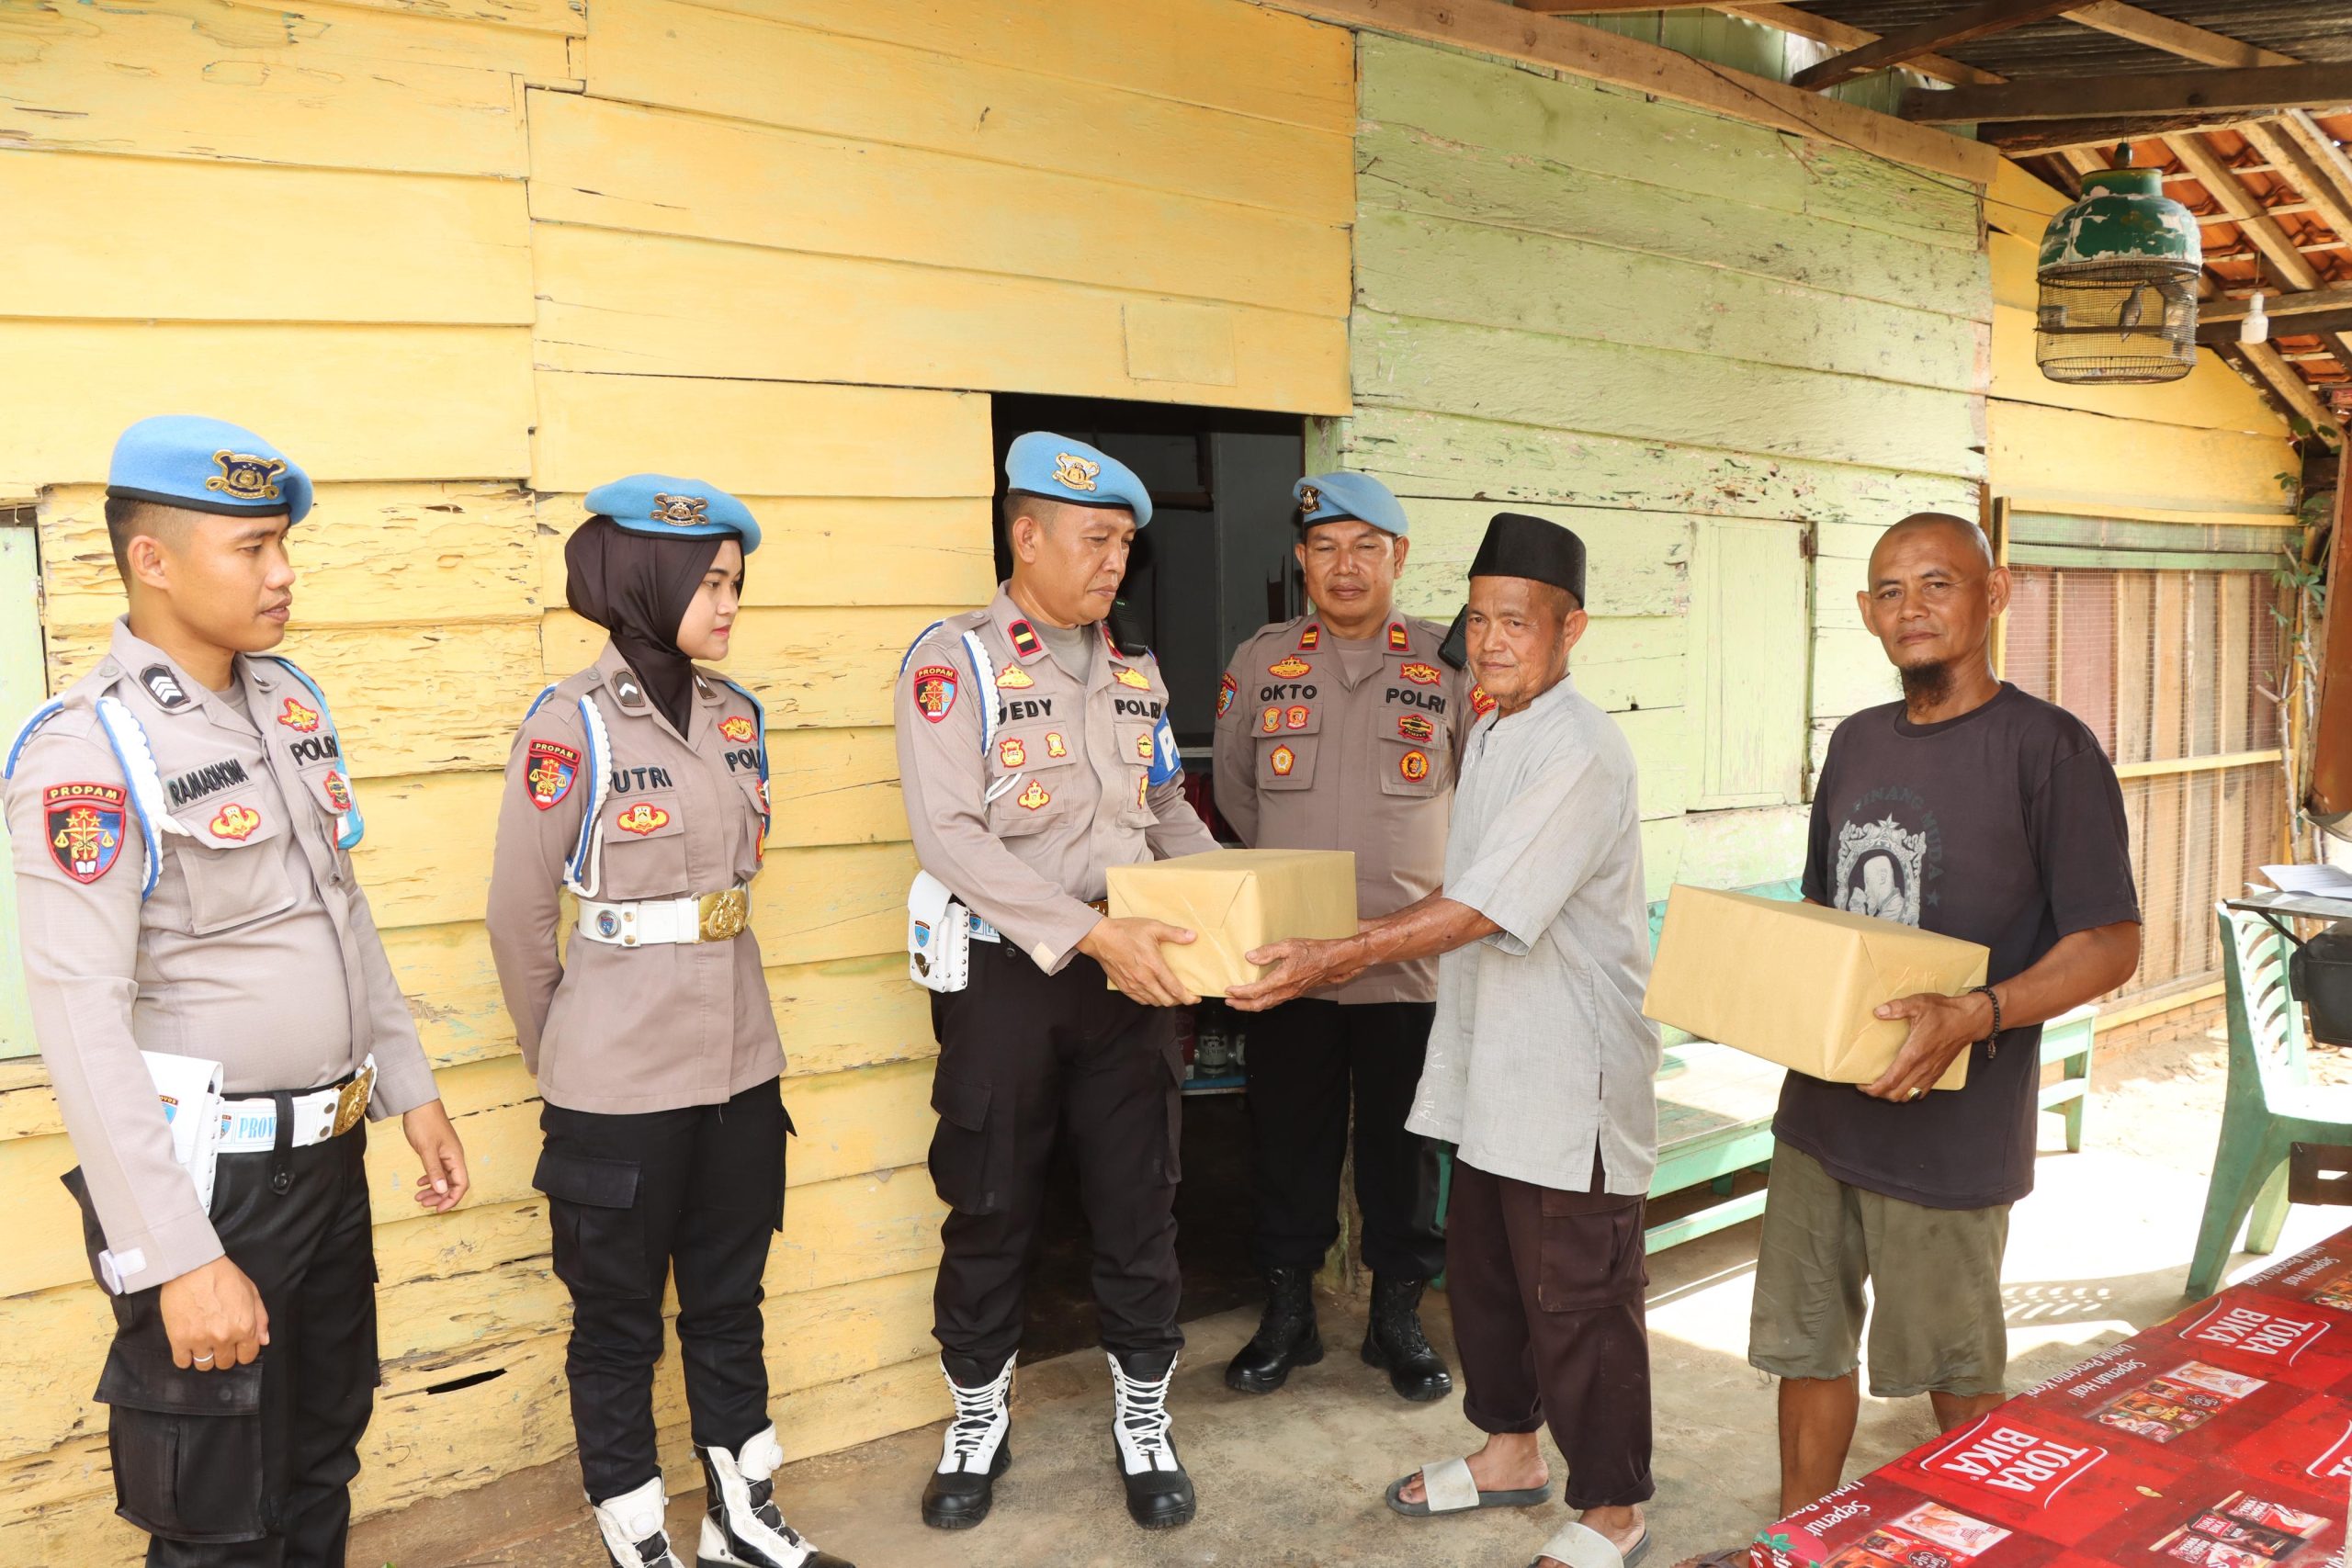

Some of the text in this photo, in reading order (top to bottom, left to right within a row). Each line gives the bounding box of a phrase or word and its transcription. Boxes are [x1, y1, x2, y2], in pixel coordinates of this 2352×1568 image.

[918, 667, 955, 679] PROPAM
[1260, 683, 1318, 702] OKTO
[1385, 687, 1447, 715] POLRI
[535, 741, 575, 760] PROPAM
[724, 748, 761, 773] POL
[49, 784, 119, 801] PROPAM
[609, 766, 673, 794] UTRI
[1920, 809, 1946, 881] MUDA
[2197, 1307, 2271, 1344] BIKA
[2235, 1317, 2314, 1355] TORA
[2066, 1359, 2147, 1398] Sepenuh Hati
[1939, 1427, 2040, 1477] BIKA
[1984, 1440, 2090, 1493] TORA
